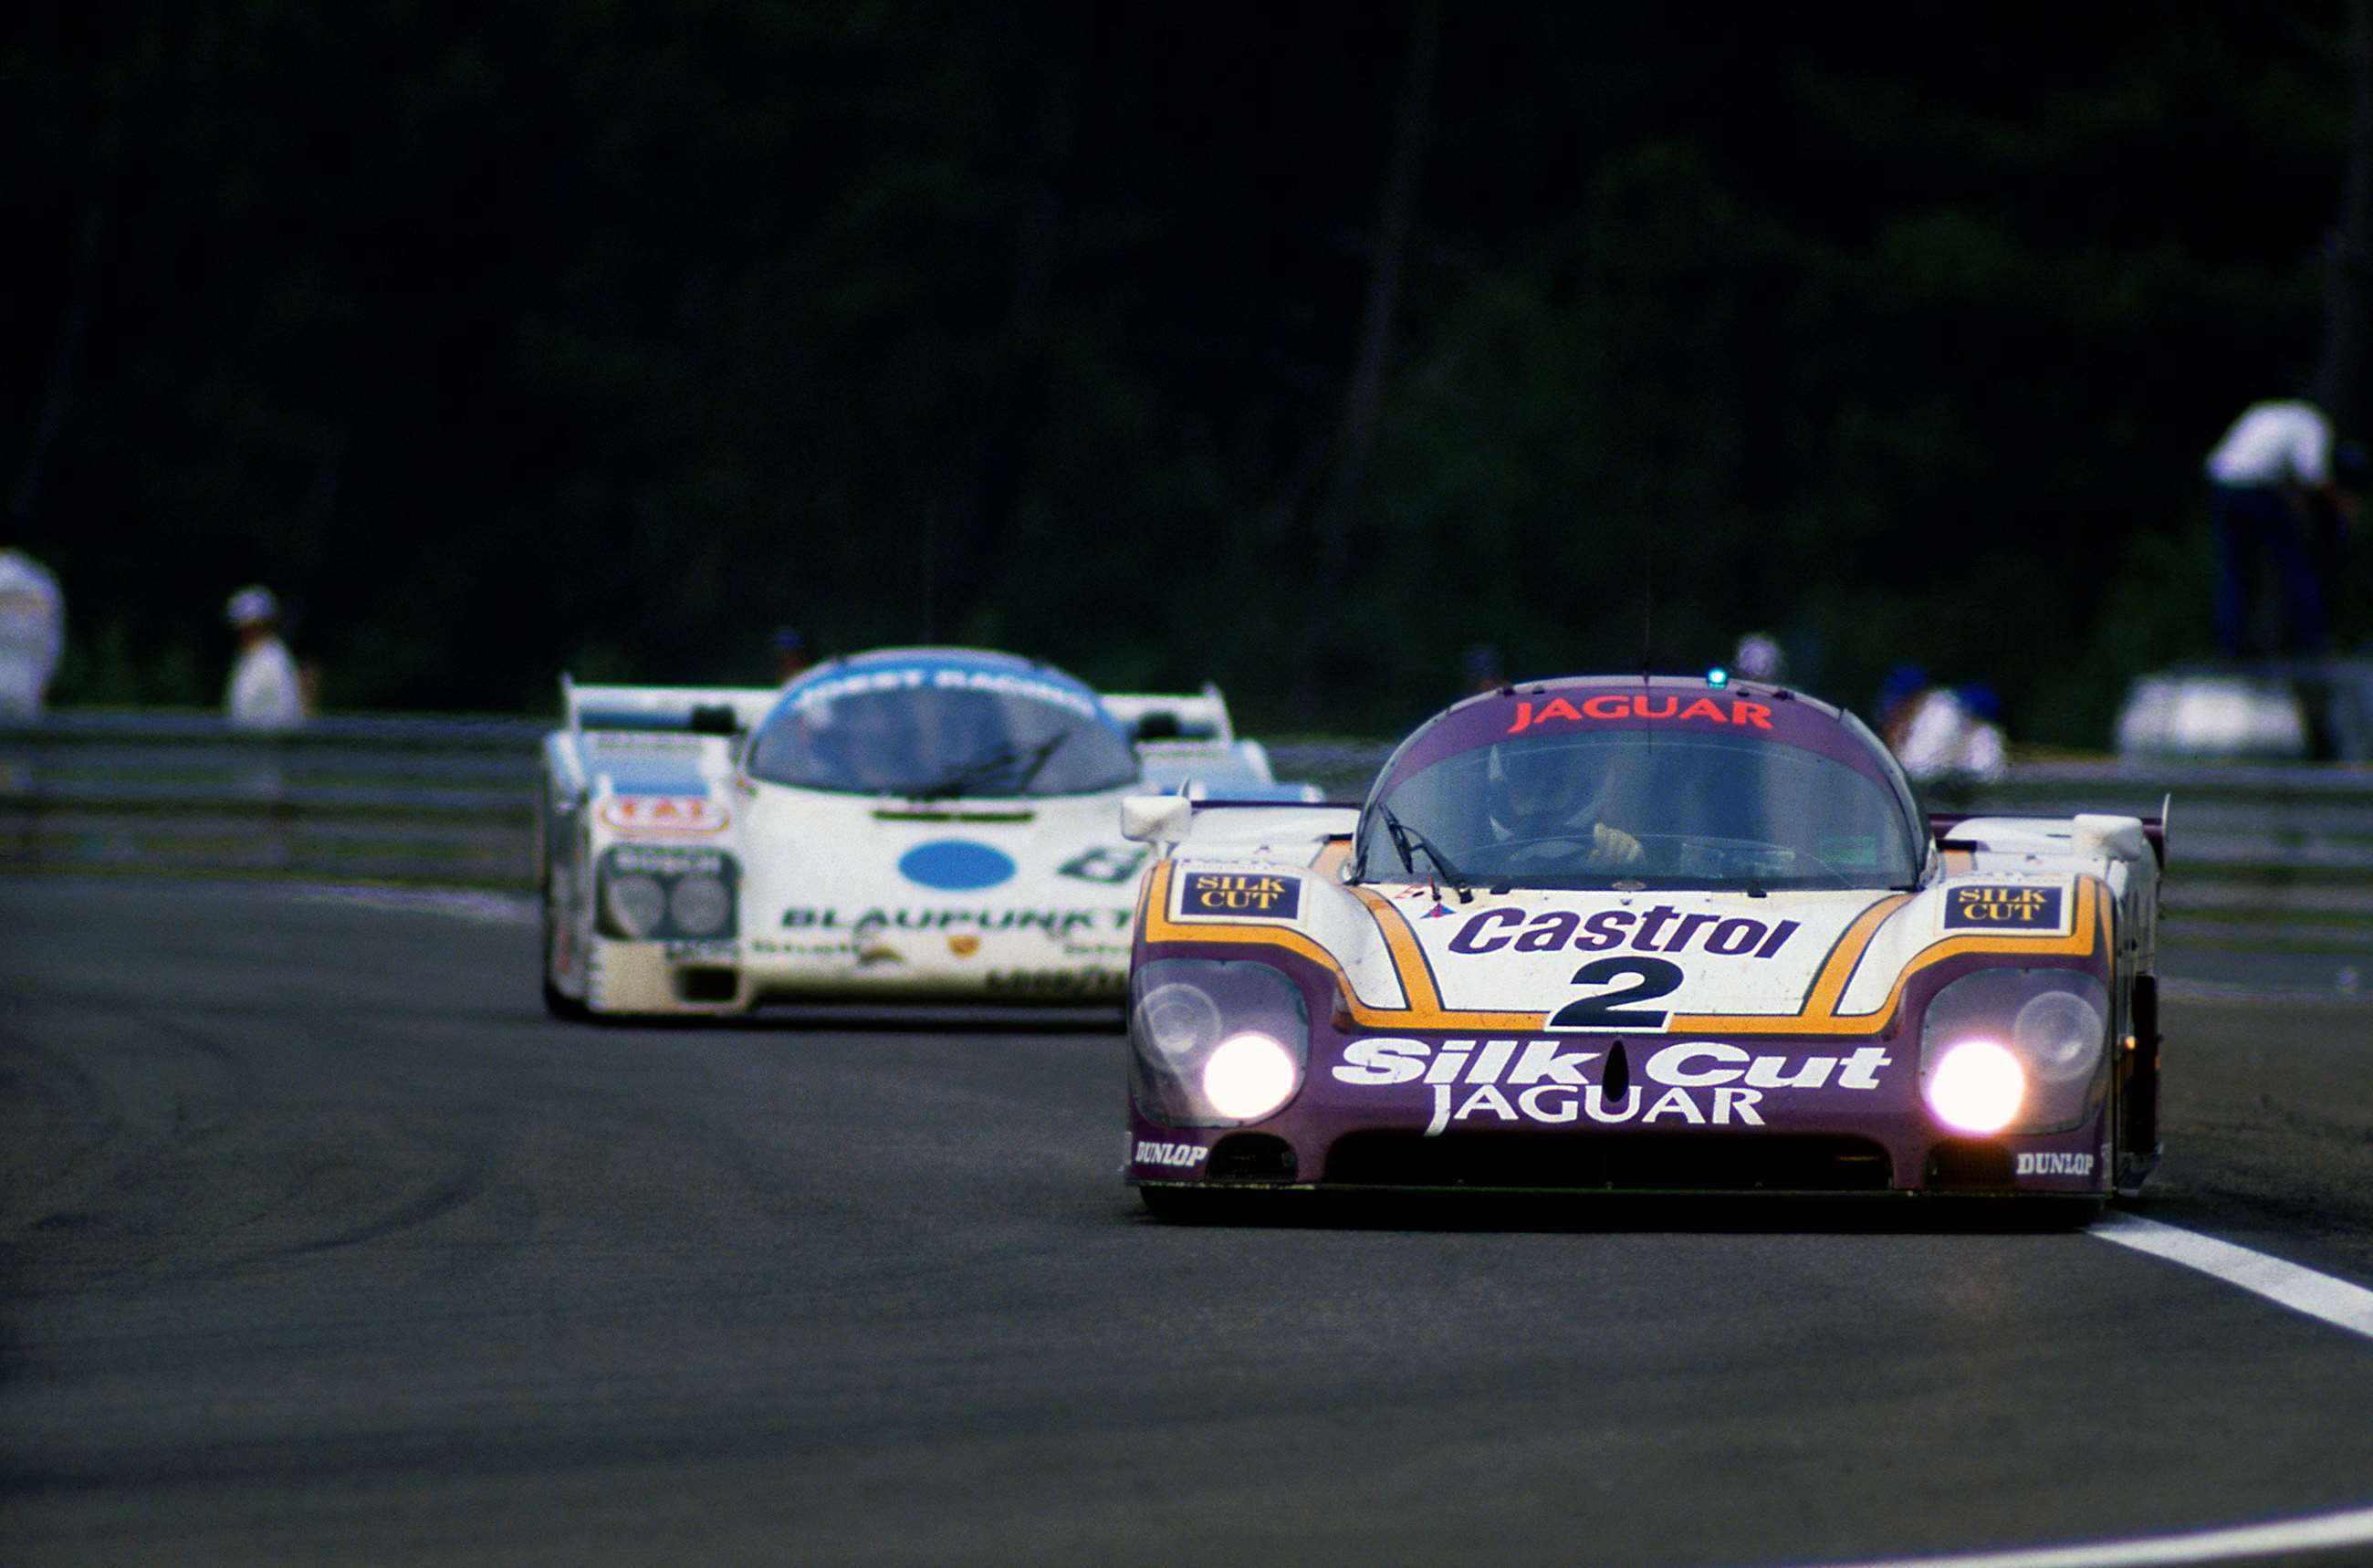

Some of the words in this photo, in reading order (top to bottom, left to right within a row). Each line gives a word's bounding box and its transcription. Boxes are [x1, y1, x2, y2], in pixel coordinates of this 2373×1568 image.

[1506, 695, 1774, 734] JAGUAR
[1197, 875, 1286, 892] SILK
[1958, 888, 2047, 904] SILK
[1200, 891, 1279, 910] CUT
[1963, 903, 2042, 921] CUT
[780, 907, 1134, 931] BLAUPUNKT
[1448, 904, 1801, 959] Castrol
[1546, 955, 1686, 1030] 2
[1332, 1037, 1603, 1086] Silk
[1646, 1041, 1893, 1091] Cut
[1423, 1084, 1767, 1137] JAGUAR
[1134, 1141, 1209, 1167] DUNLOP
[2016, 1152, 2095, 1176] DUNLOP
